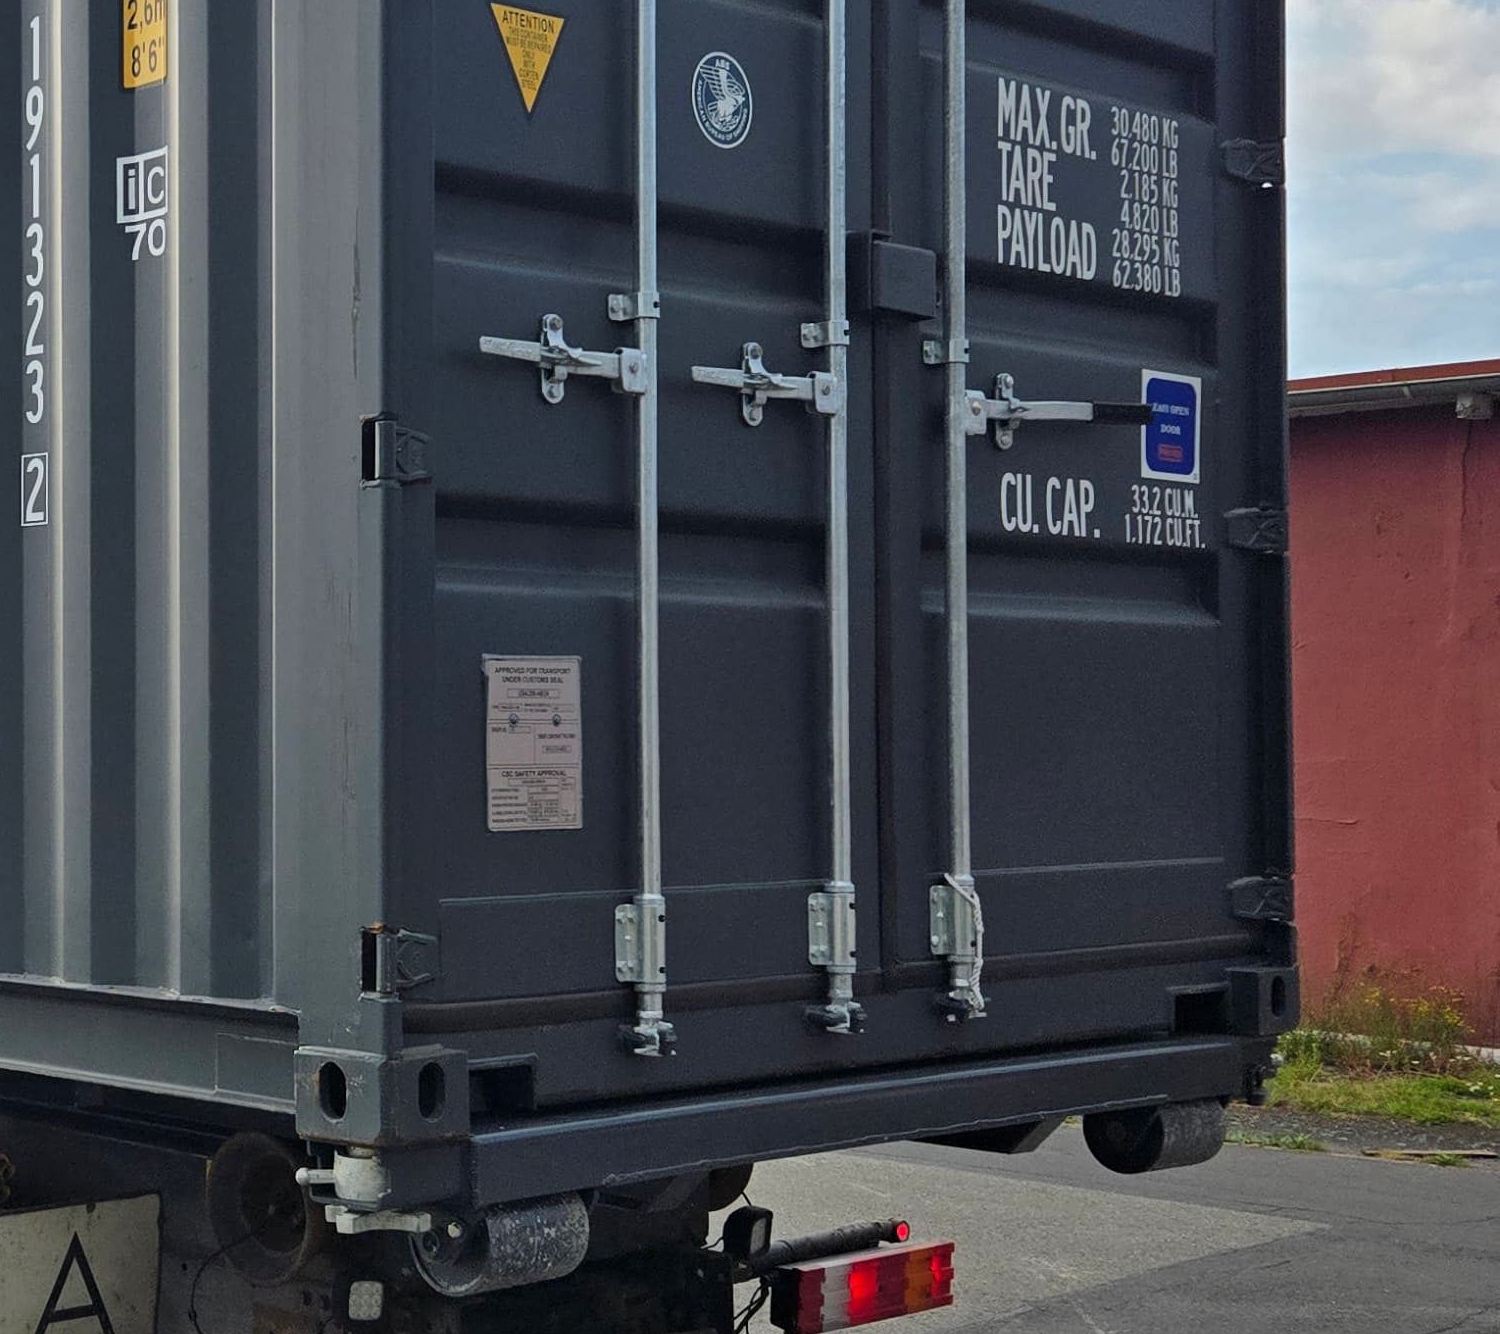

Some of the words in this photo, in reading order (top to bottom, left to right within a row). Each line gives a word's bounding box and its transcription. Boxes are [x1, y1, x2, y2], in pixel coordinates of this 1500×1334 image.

[501, 10, 555, 34] ATTENTION
[998, 77, 1057, 150] MAX.
[1060, 95, 1097, 160] GR.
[1111, 106, 1159, 144] 30,480
[1163, 117, 1179, 149] KG
[998, 141, 1057, 211] TARE
[1163, 178, 1178, 208] KG
[1163, 147, 1178, 178] LB
[25, 16, 45, 424] 191323
[125, 219, 166, 260] 70
[998, 204, 1097, 281] PAYLOAD
[1163, 238, 1180, 267] KG
[1163, 209, 1178, 238] LB
[1164, 269, 1180, 297] LB
[1160, 424, 1181, 436] DOOR
[25, 457, 45, 522] 2
[1001, 472, 1039, 534] CU.
[1046, 476, 1100, 539] CAP.
[1131, 484, 1161, 515] 33.2
